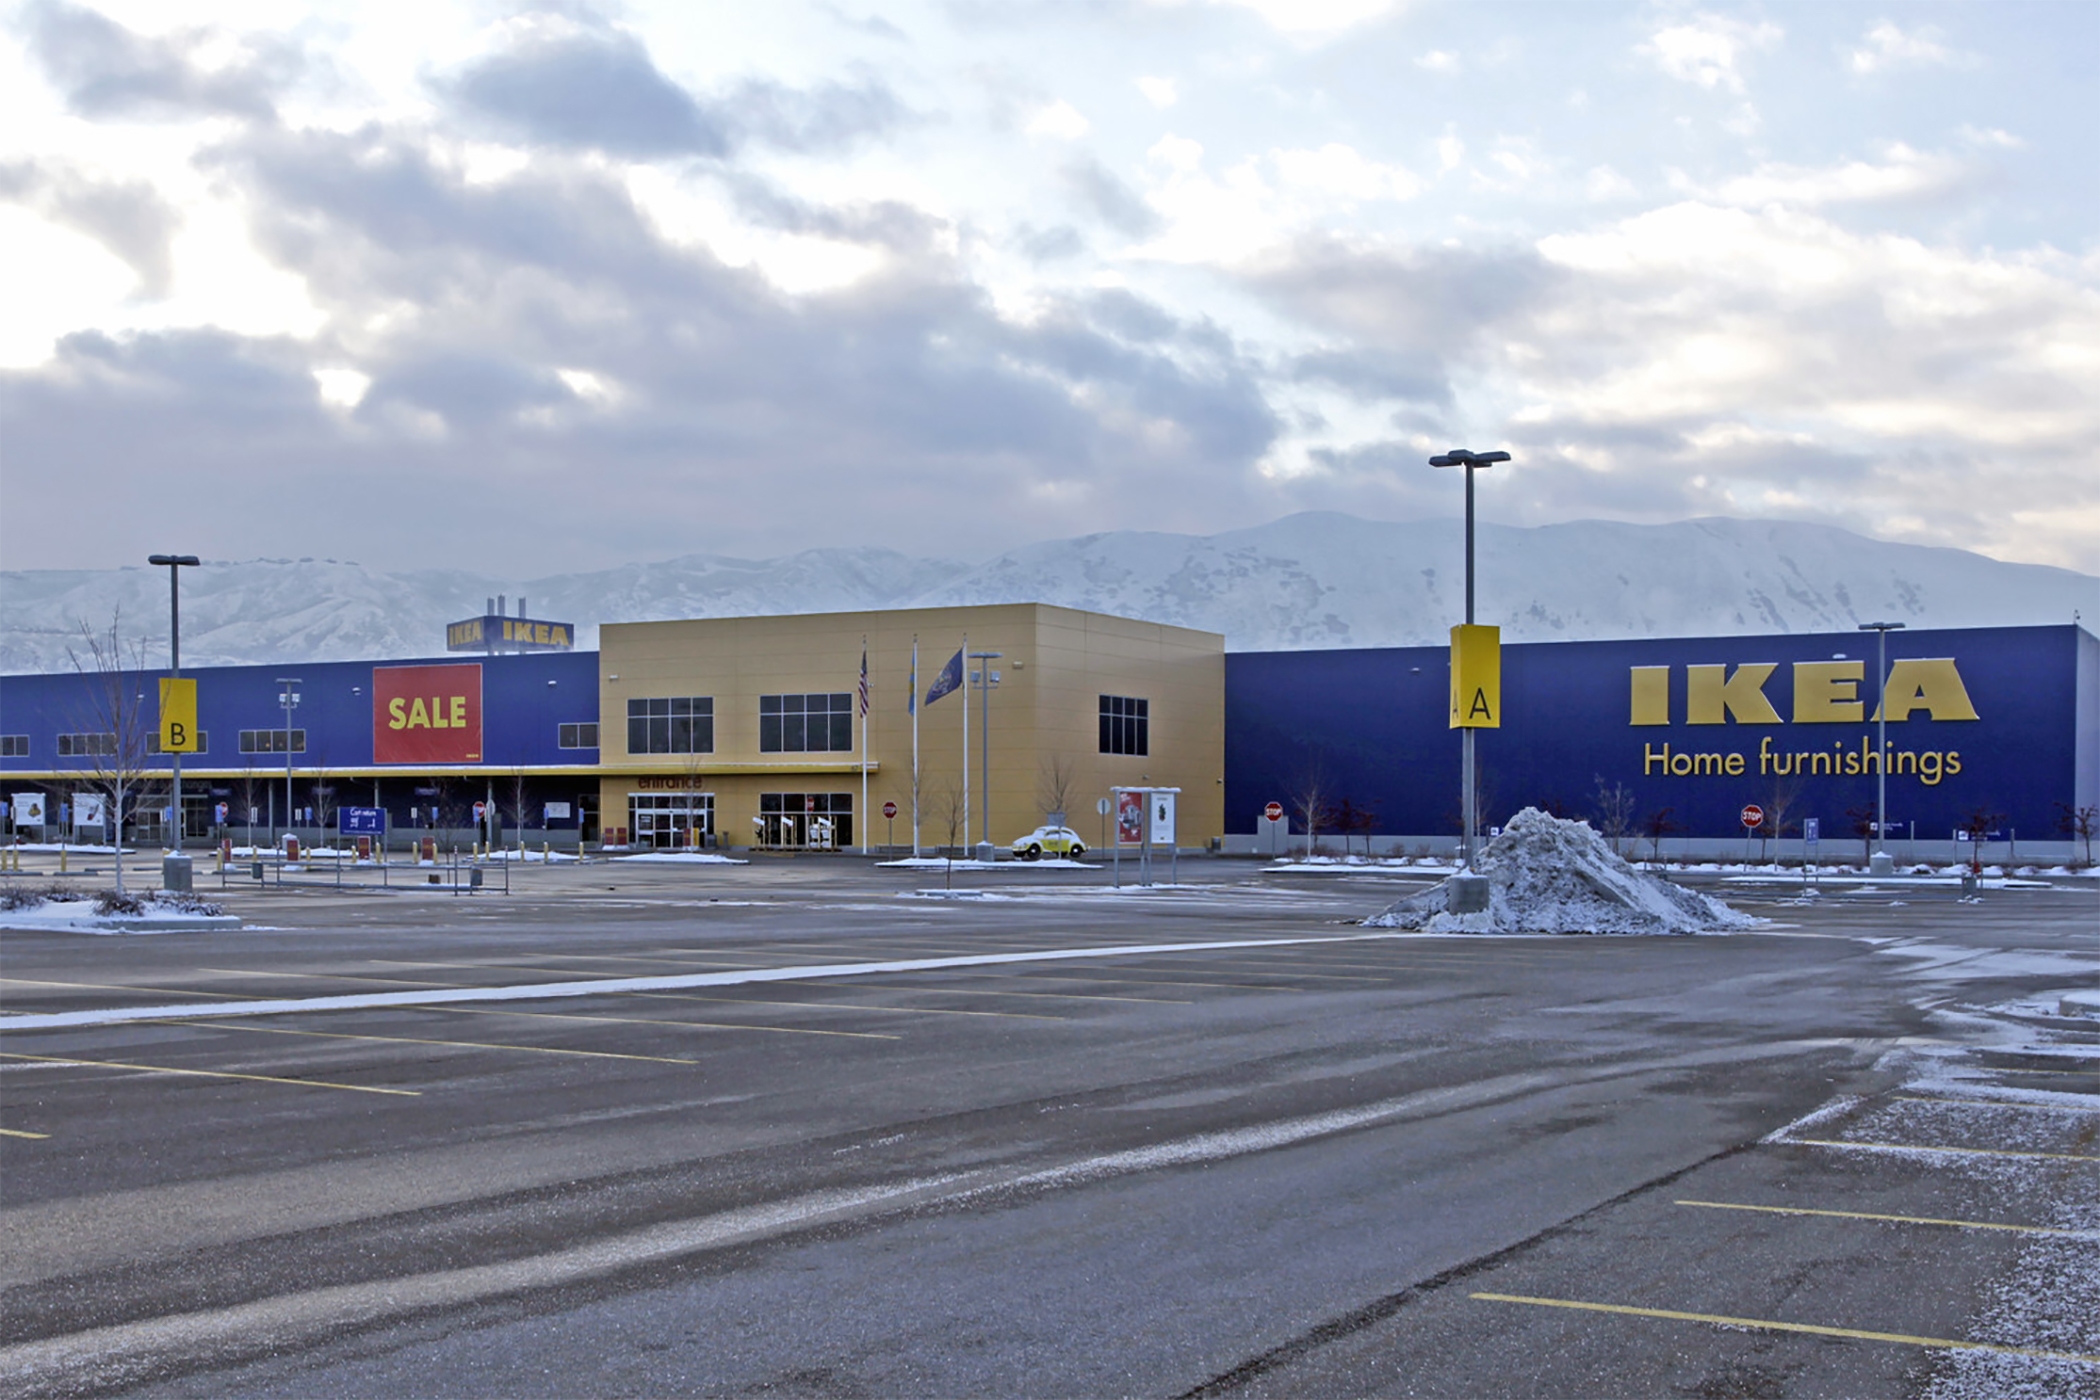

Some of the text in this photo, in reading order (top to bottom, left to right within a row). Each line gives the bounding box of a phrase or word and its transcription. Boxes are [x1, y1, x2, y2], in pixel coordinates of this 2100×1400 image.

[449, 621, 482, 646] IKEA
[503, 620, 570, 646] IKEA
[1452, 688, 1459, 720] A
[1468, 686, 1492, 720] A
[1629, 657, 1980, 726] IKEA
[388, 696, 467, 730] SALE
[170, 722, 186, 746] B
[1644, 736, 1962, 785] Home furnishings
[638, 774, 703, 789] entrance
[1743, 811, 1761, 821] STOP
